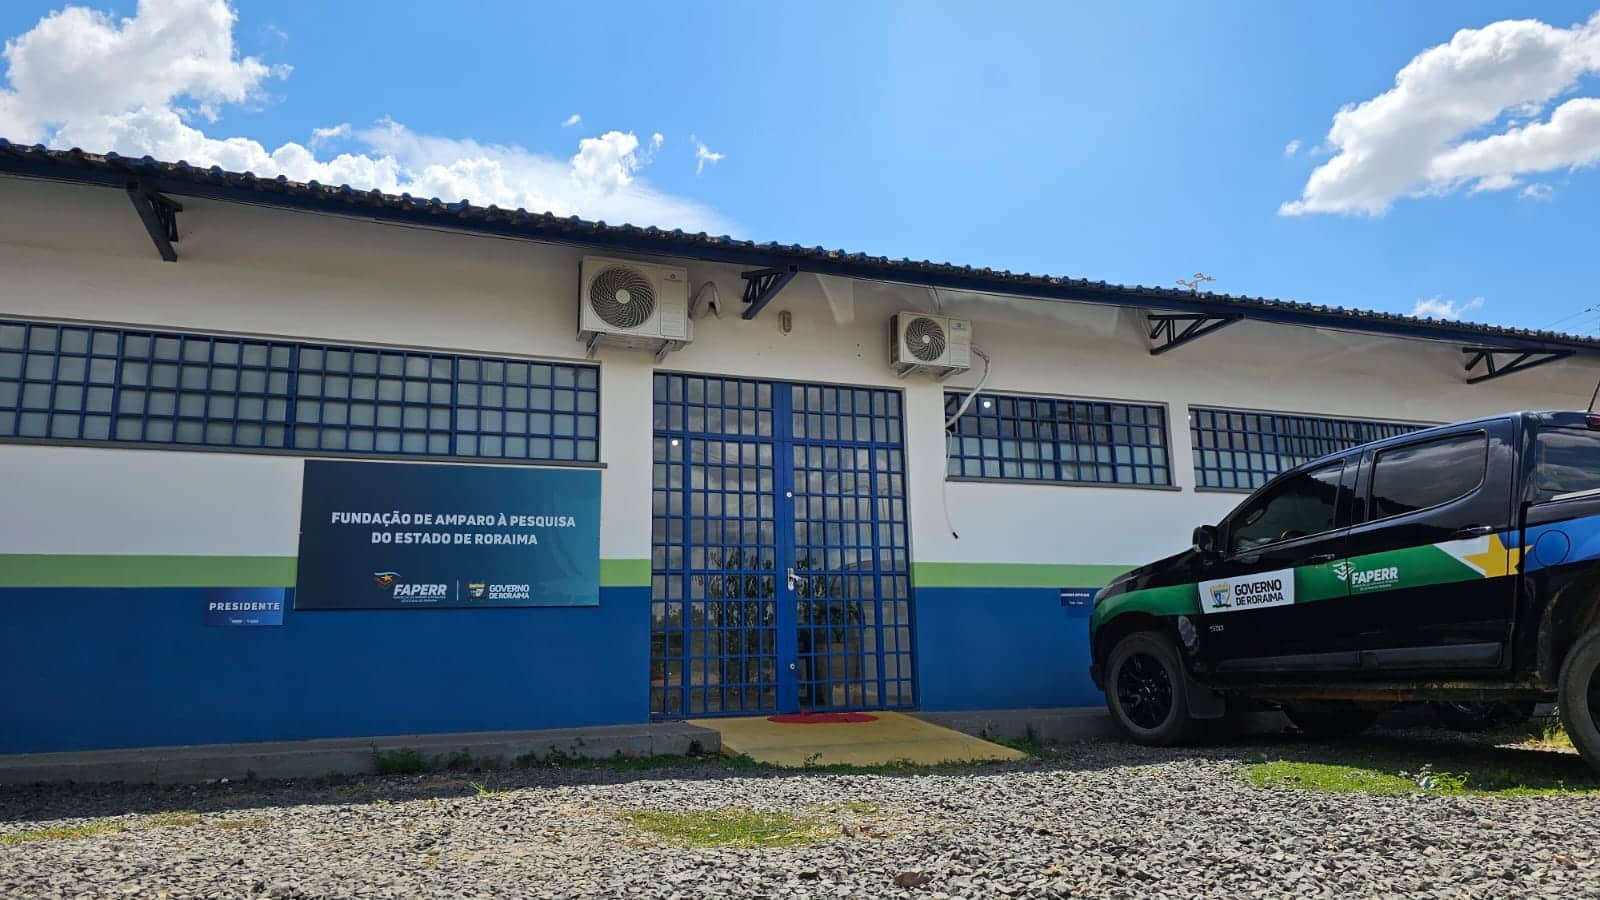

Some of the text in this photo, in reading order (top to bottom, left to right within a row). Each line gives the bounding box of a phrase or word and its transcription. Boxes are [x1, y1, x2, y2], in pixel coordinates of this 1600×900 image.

[331, 510, 576, 529] FUNDAÇÃO DE AMPARO À PESQUISA
[371, 532, 538, 545] DO ESTADO DE RORAIMA
[1351, 567, 1399, 585] FAPERR
[393, 583, 448, 597] FAPERR
[489, 584, 530, 593] GOVERNO
[1234, 579, 1282, 596] GOVERNO
[1235, 592, 1284, 606] DE RORAIMA
[208, 602, 281, 611] PRESIDENTE
